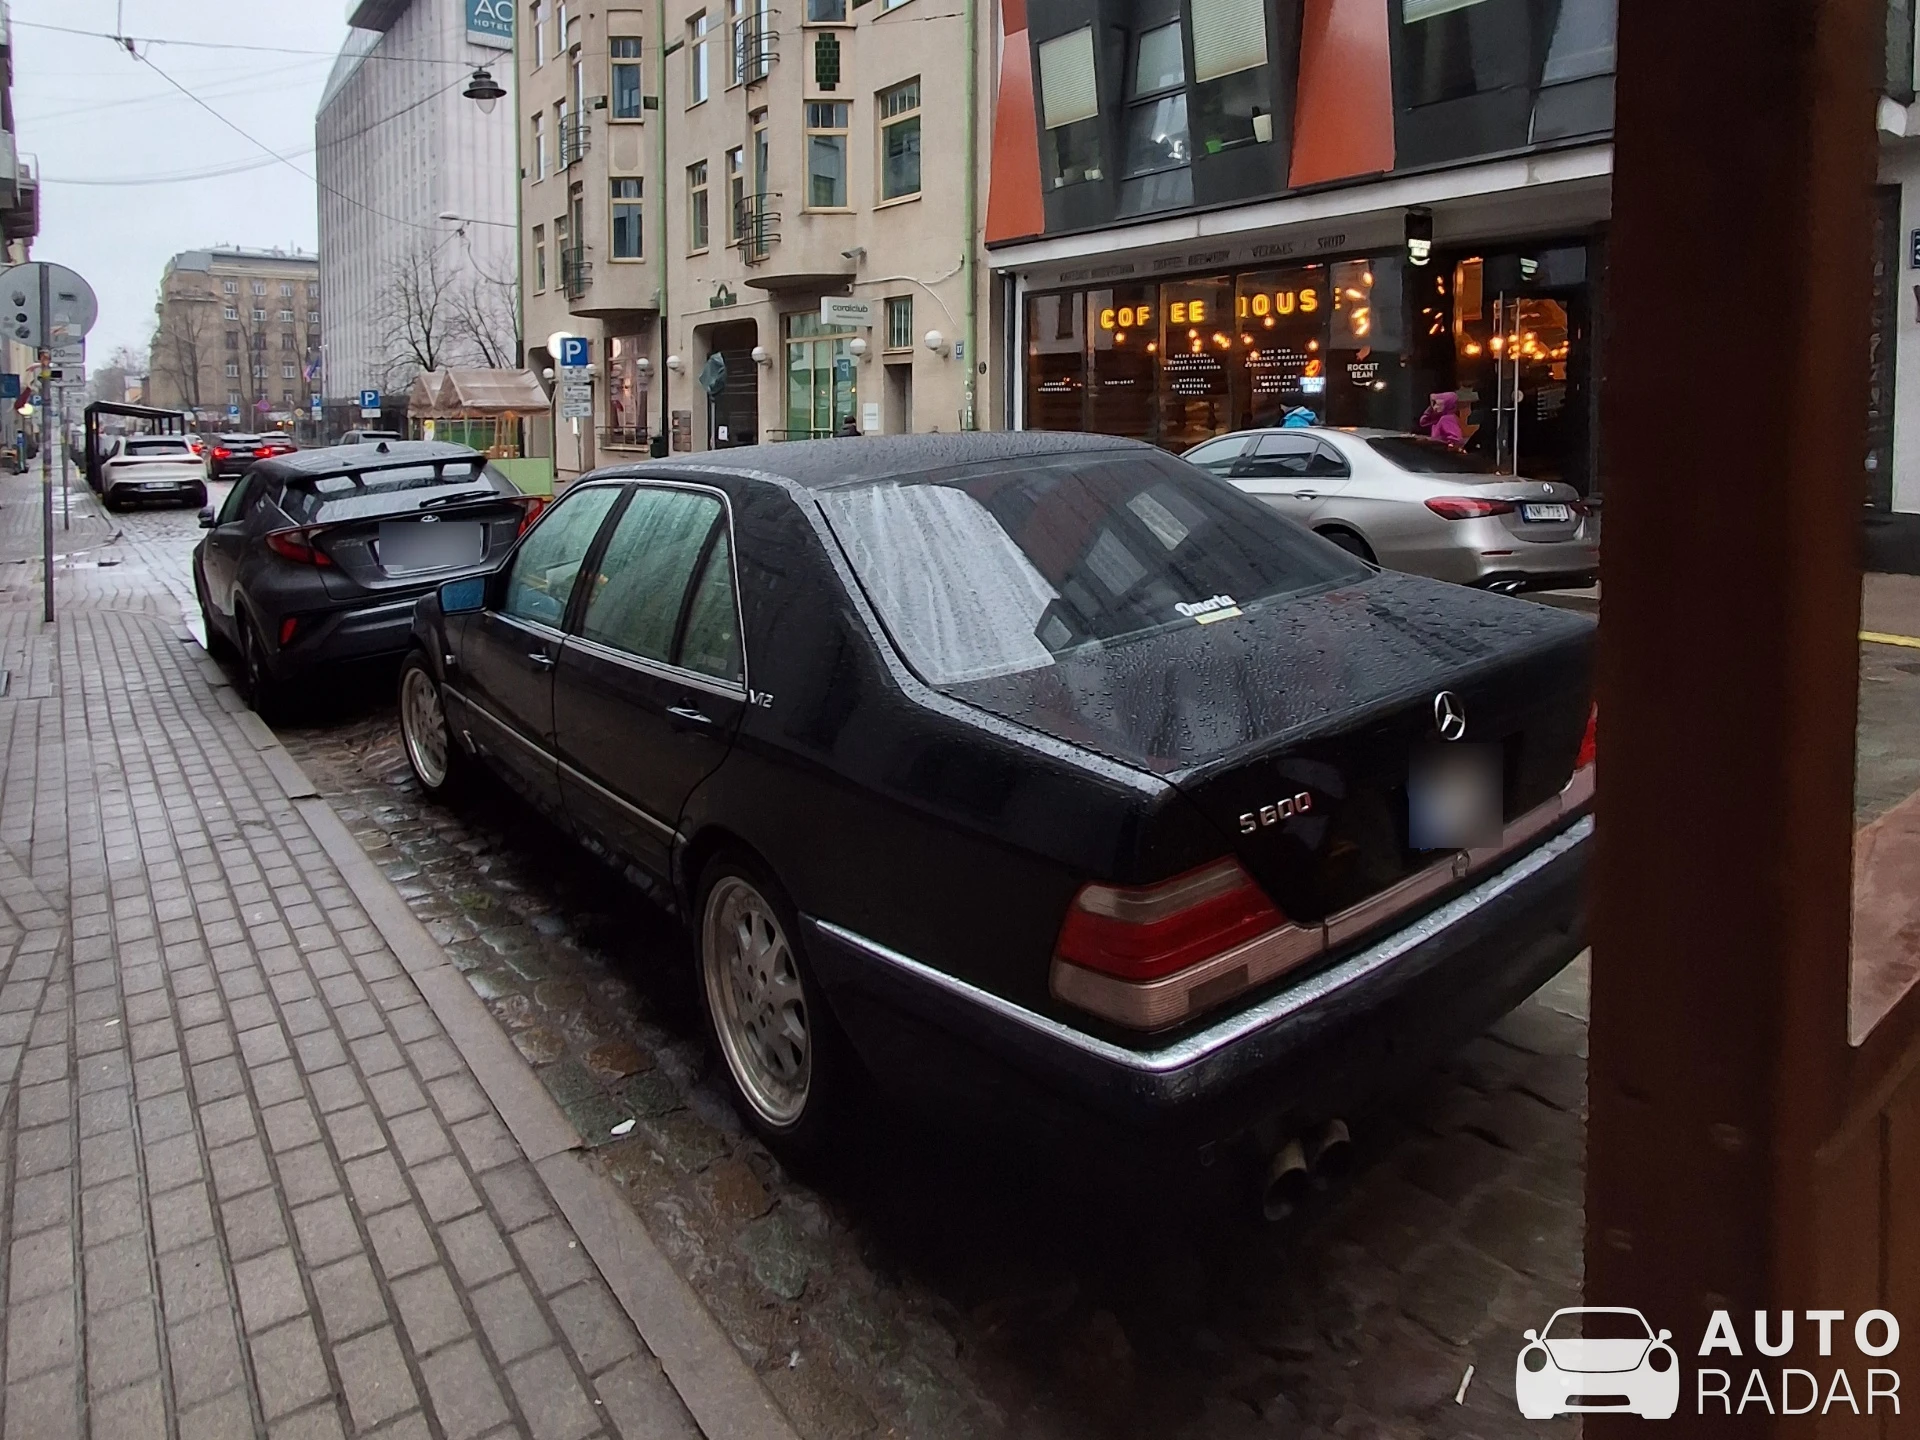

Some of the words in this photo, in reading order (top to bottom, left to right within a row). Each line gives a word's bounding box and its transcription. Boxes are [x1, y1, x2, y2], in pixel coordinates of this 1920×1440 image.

[473, 18, 513, 32] HOTEL
[565, 340, 582, 364] P
[1347, 363, 1379, 371] ROCKET
[1351, 371, 1374, 379] BEAN
[364, 391, 376, 405] P
[749, 689, 774, 708] V12
